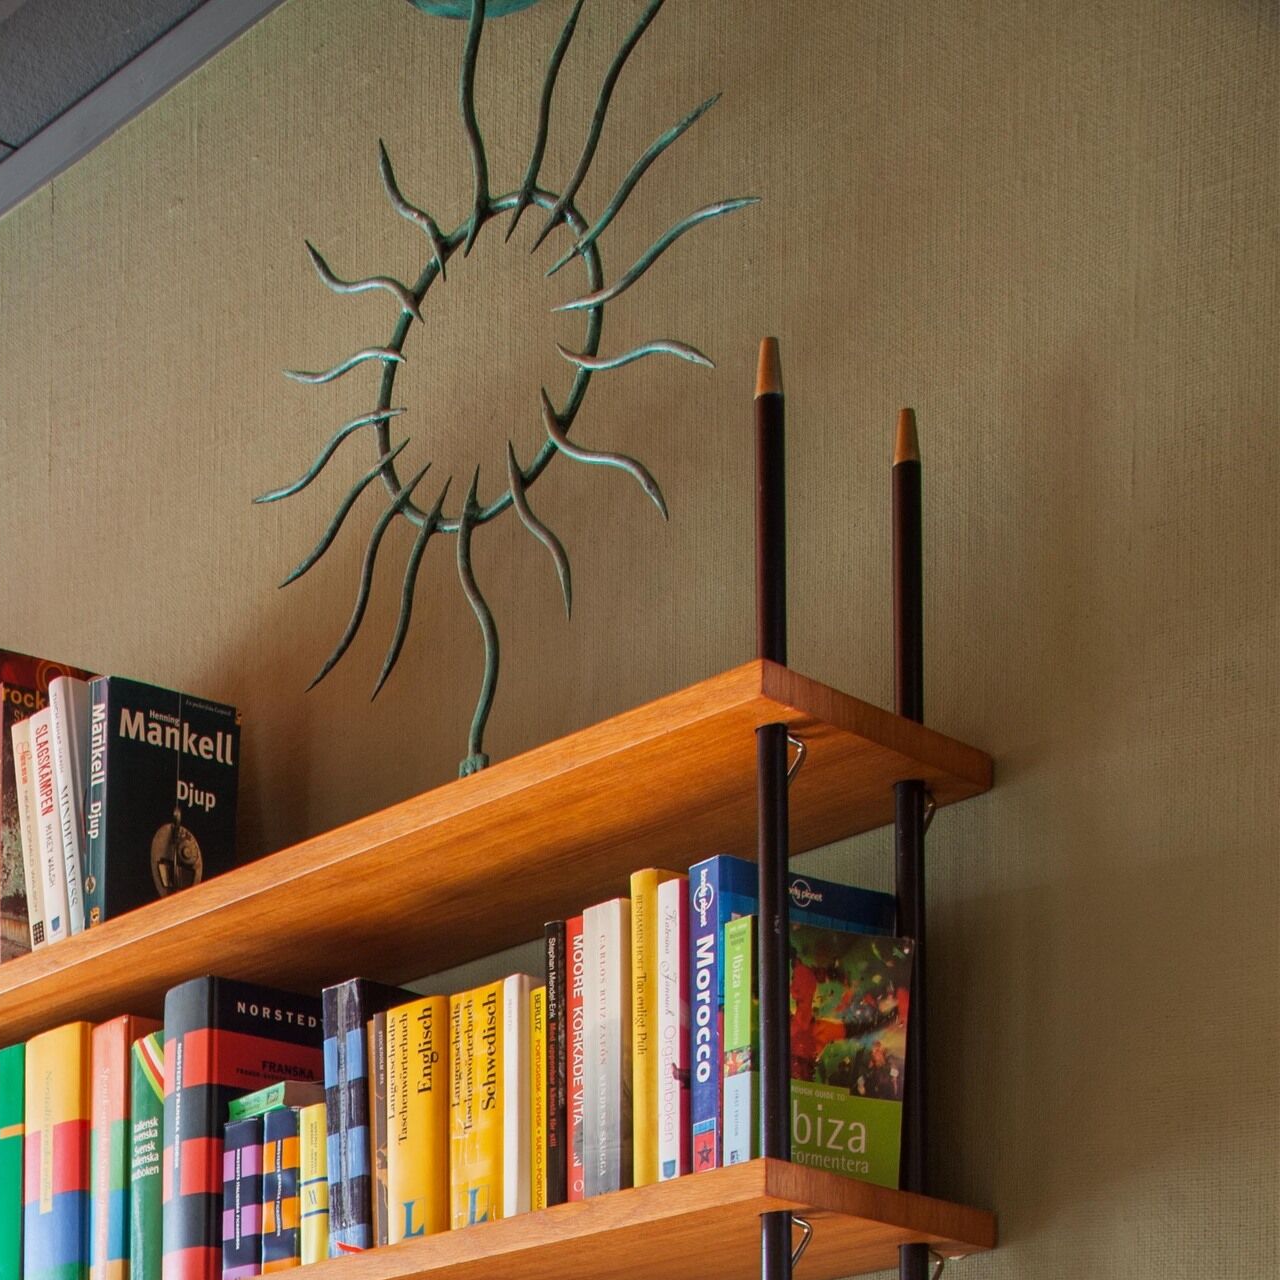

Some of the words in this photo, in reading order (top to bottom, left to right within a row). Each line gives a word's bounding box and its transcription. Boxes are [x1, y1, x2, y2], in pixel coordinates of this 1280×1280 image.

[3, 688, 45, 708] rock
[149, 709, 180, 725] Henning
[90, 702, 106, 787] Mankell
[120, 708, 234, 766] Mankell
[35, 724, 54, 817] SLAGSKÄMPEN
[177, 780, 216, 811] Djup
[46, 823, 54, 853] MIKEY
[87, 800, 102, 840] Djup
[59, 785, 78, 907] MINDFULNESS
[48, 856, 56, 888] WALSH
[699, 868, 709, 898] lonely
[699, 899, 709, 928] planet
[805, 888, 823, 902] planet
[635, 894, 644, 944] BENJAMIN
[547, 937, 556, 970] Stephan
[572, 934, 583, 1000] MOORE
[598, 933, 607, 984] CARLOS
[636, 945, 644, 970] HOFF
[732, 954, 743, 988] Ibiza
[547, 971, 556, 1019] Mendel-Erik
[636, 972, 647, 993] Tao
[237, 1002, 324, 1028] NORSTED
[534, 993, 542, 1032] BERLITZ
[598, 989, 607, 1020] RUIZ
[633, 996, 647, 1028] enligt
[696, 933, 714, 1083] Morocco
[417, 1005, 439, 1094] Englisch
[452, 1002, 461, 1107] Langenscheidts
[481, 991, 497, 1111] Schwedisch
[572, 1005, 583, 1086] KORKADE
[637, 1032, 647, 1056] Puh
[262, 1061, 314, 1080] FRANSKA
[388, 1016, 396, 1120] Langenscheidts
[398, 1012, 408, 1146] Taschenwörterbuch
[463, 999, 474, 1135] Taschenwörterbuch
[661, 1024, 678, 1143] Orgasmboken
[43, 1071, 53, 1121] Norstedts
[572, 1091, 583, 1127] VITA
[815, 1089, 833, 1099] GUIDE
[793, 1099, 866, 1154] biza
